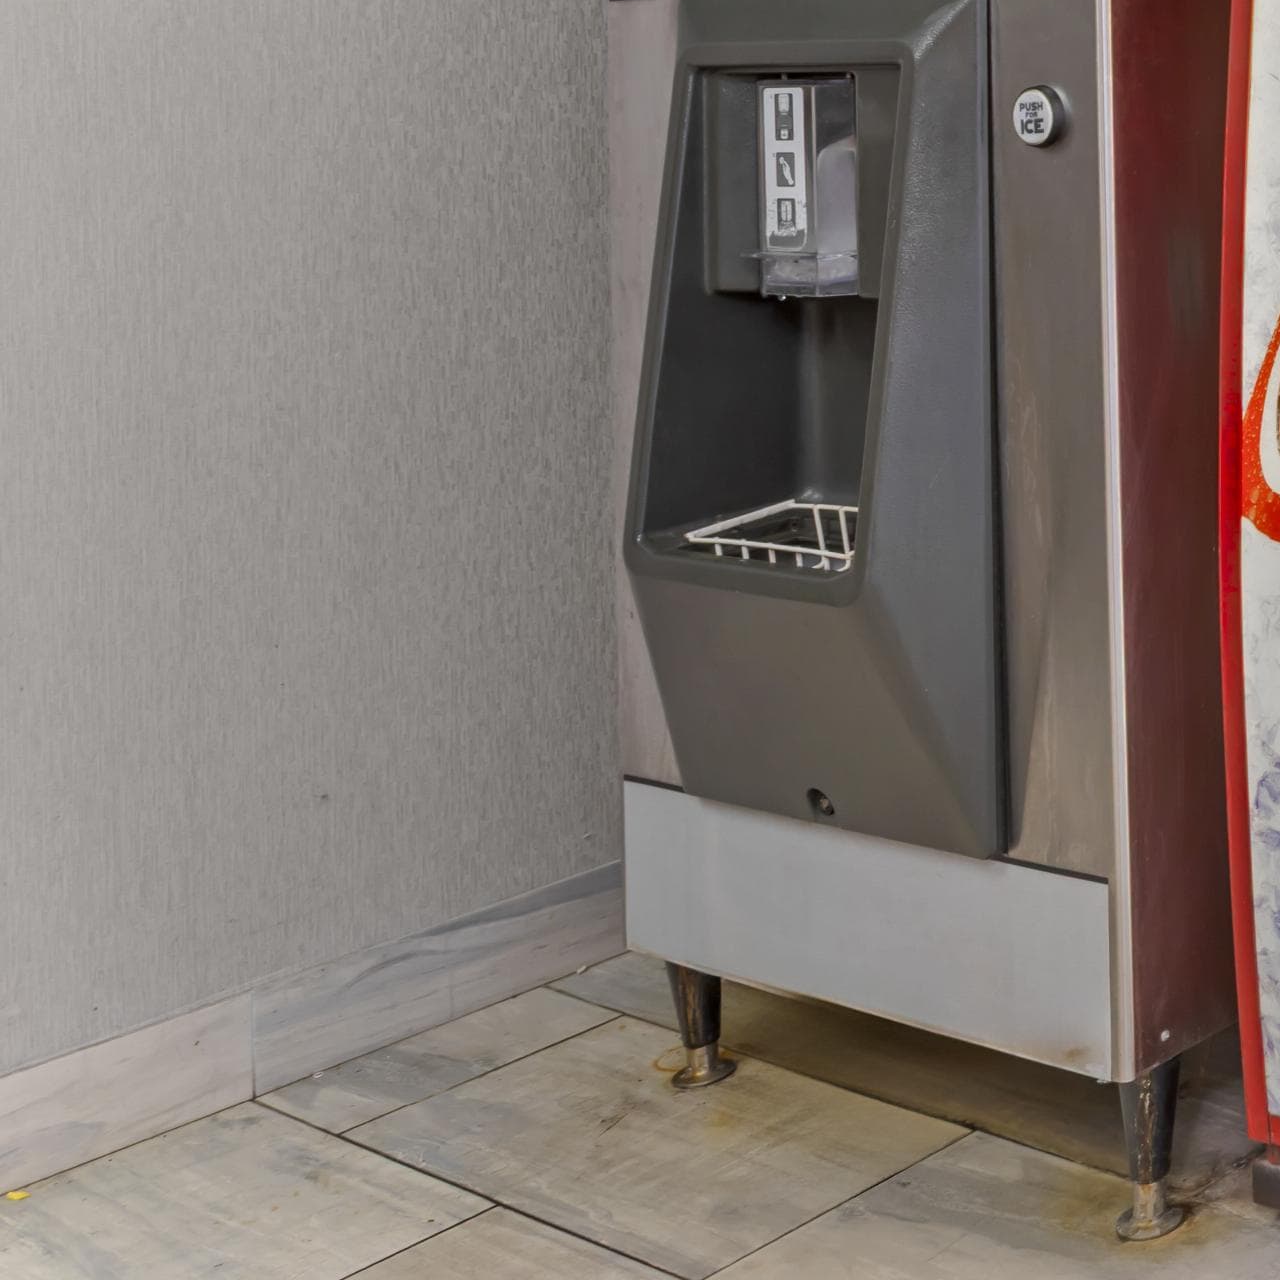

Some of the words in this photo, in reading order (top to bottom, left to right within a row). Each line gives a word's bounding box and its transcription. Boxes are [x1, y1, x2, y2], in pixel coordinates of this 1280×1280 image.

[1019, 101, 1044, 113] PUSH
[1025, 111, 1039, 119] FOR
[1020, 119, 1044, 134] ICE
